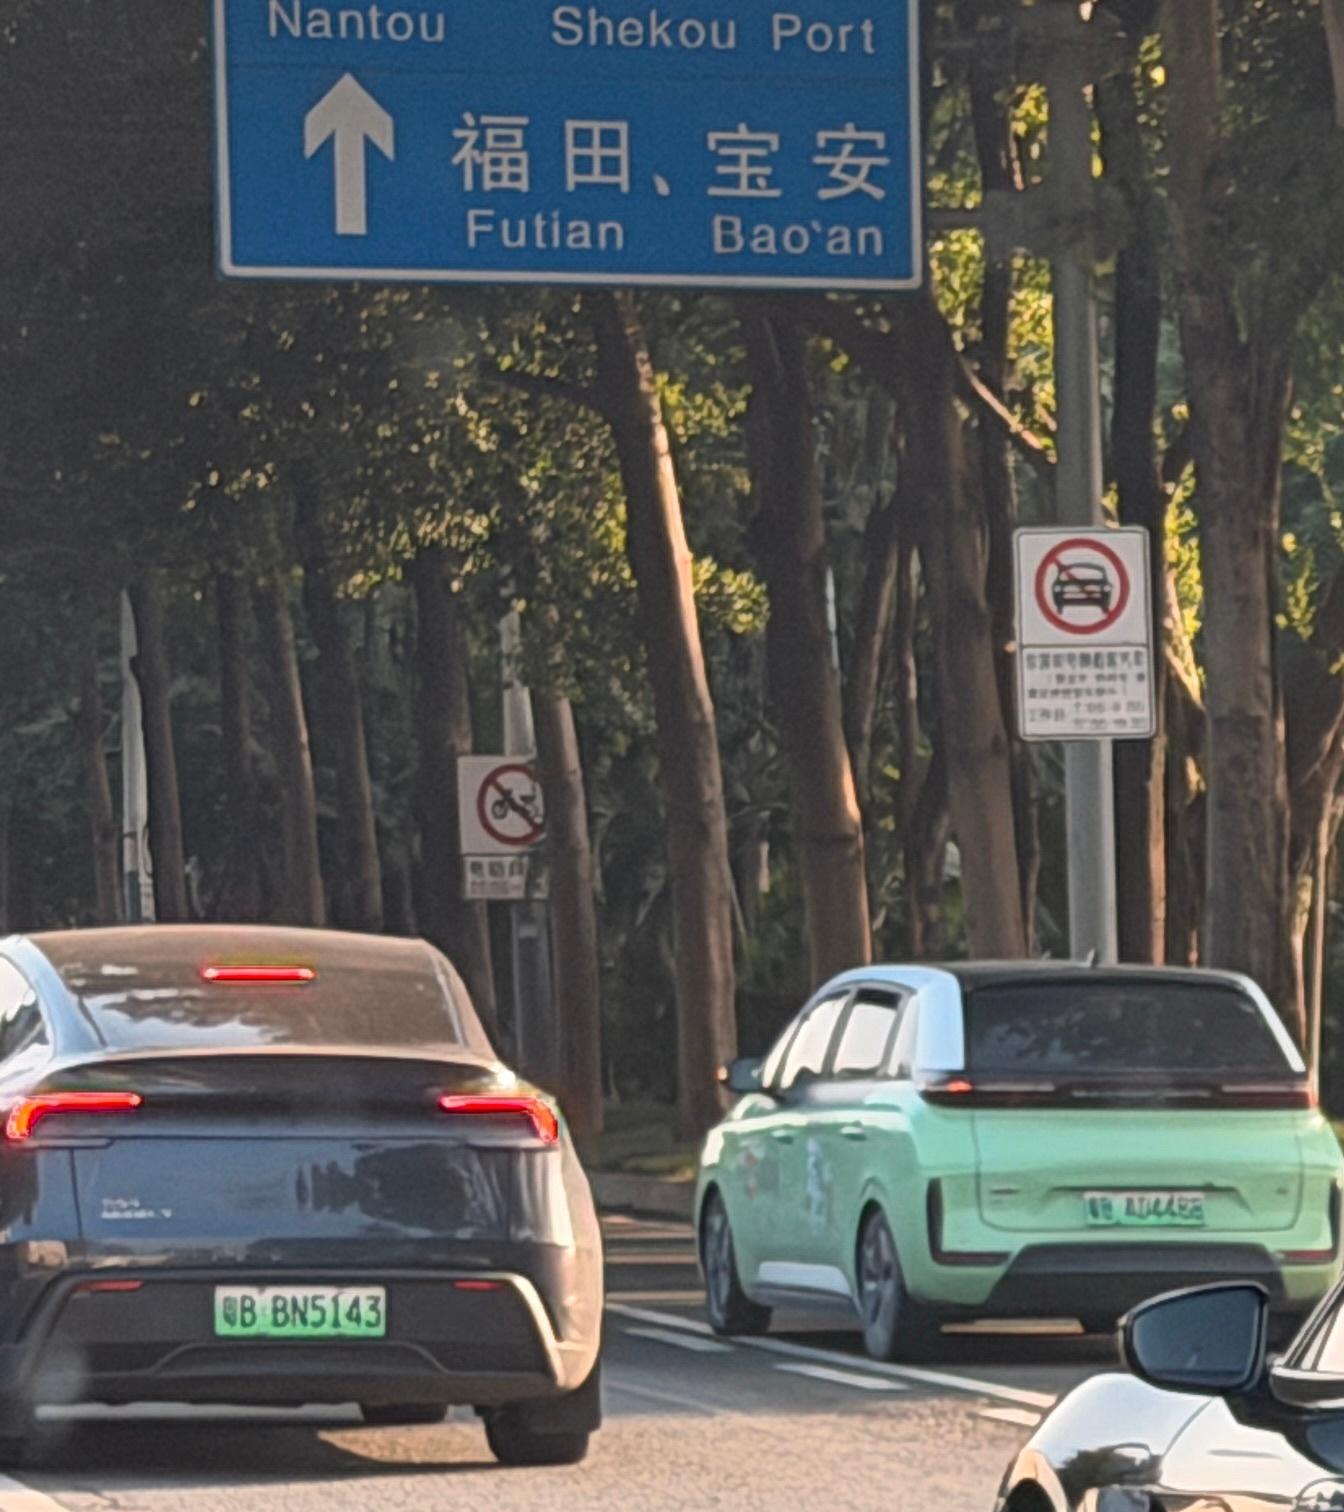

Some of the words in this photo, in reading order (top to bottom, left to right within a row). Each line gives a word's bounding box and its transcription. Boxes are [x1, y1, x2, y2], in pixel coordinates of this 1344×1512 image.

[268, 0, 445, 41] Nantou
[551, 6, 736, 50] Shekou
[772, 13, 875, 54] Port
[466, 208, 624, 250] Futian
[271, 1295, 382, 1328] BN5143
